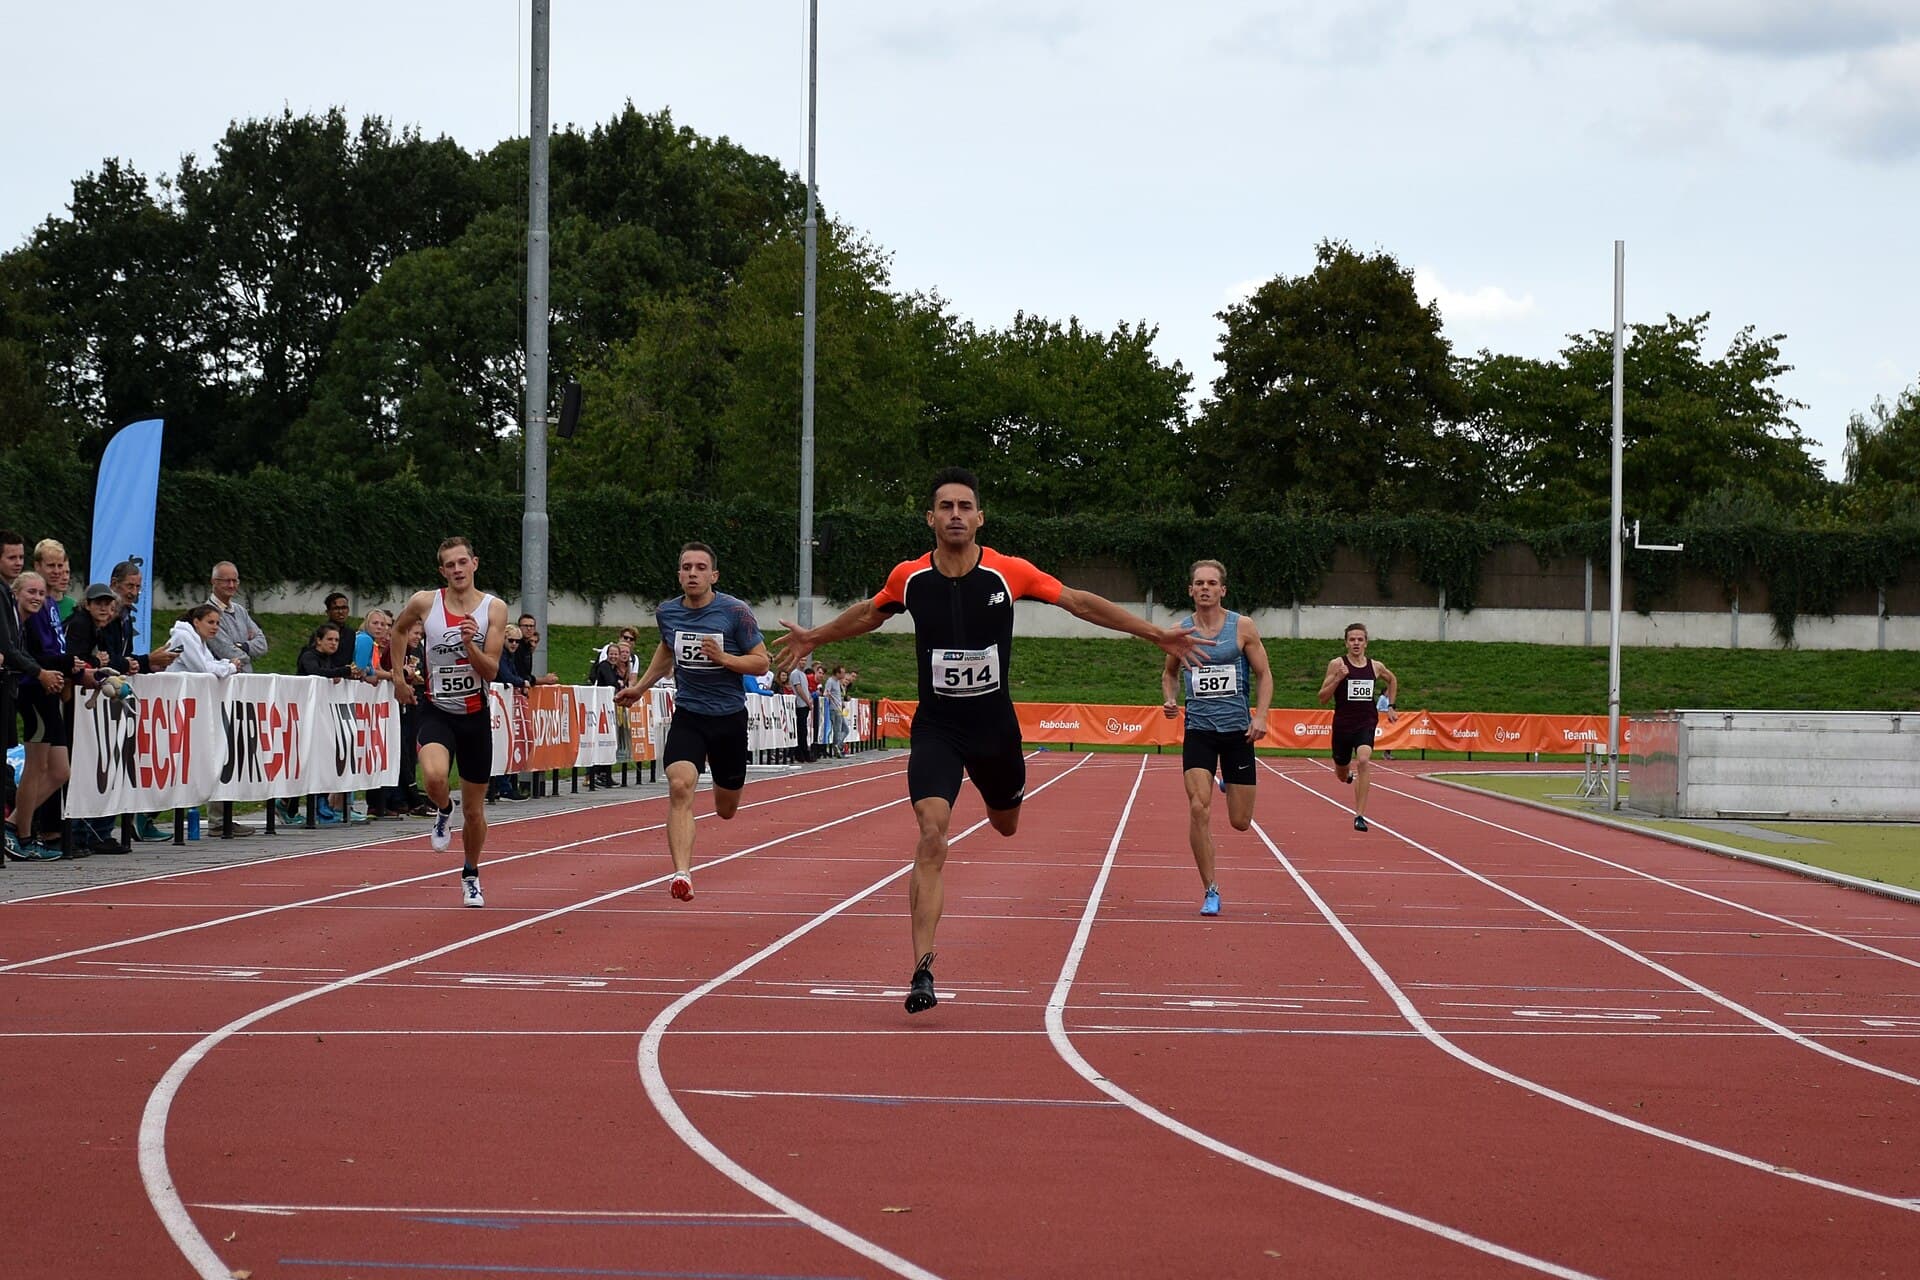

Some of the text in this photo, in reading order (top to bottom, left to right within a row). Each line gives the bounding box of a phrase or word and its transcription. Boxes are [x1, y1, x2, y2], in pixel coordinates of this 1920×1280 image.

[682, 645, 713, 661] 52
[944, 665, 992, 686] 514
[441, 676, 475, 692] 550
[1199, 676, 1230, 691] 587
[1353, 687, 1371, 696] 508
[1040, 720, 1080, 729] Rabobank
[1122, 722, 1142, 731] kpn
[1505, 731, 1520, 740] kpn
[1563, 729, 1598, 741] TeamNL
